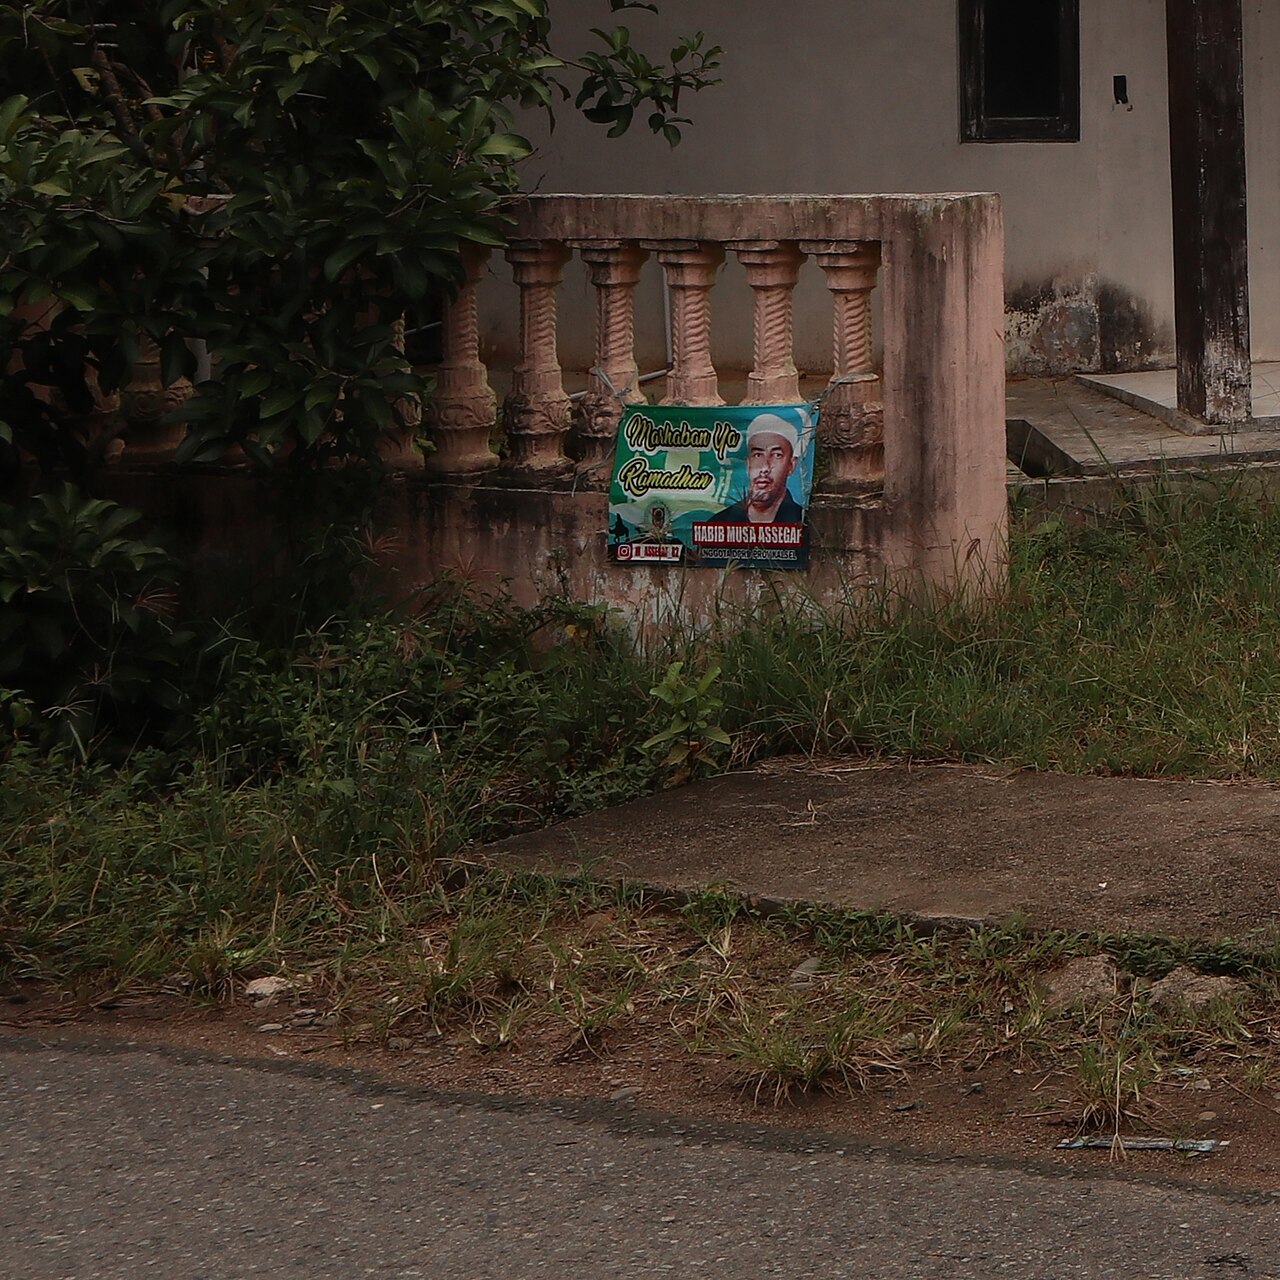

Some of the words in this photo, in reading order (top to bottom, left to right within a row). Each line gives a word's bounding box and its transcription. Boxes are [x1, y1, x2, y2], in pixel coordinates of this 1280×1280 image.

[625, 413, 711, 452] Marhaban
[712, 422, 741, 460] Ya
[619, 457, 713, 497] Ramadhan
[694, 525, 725, 542] HABIB
[726, 526, 755, 543] MUSA
